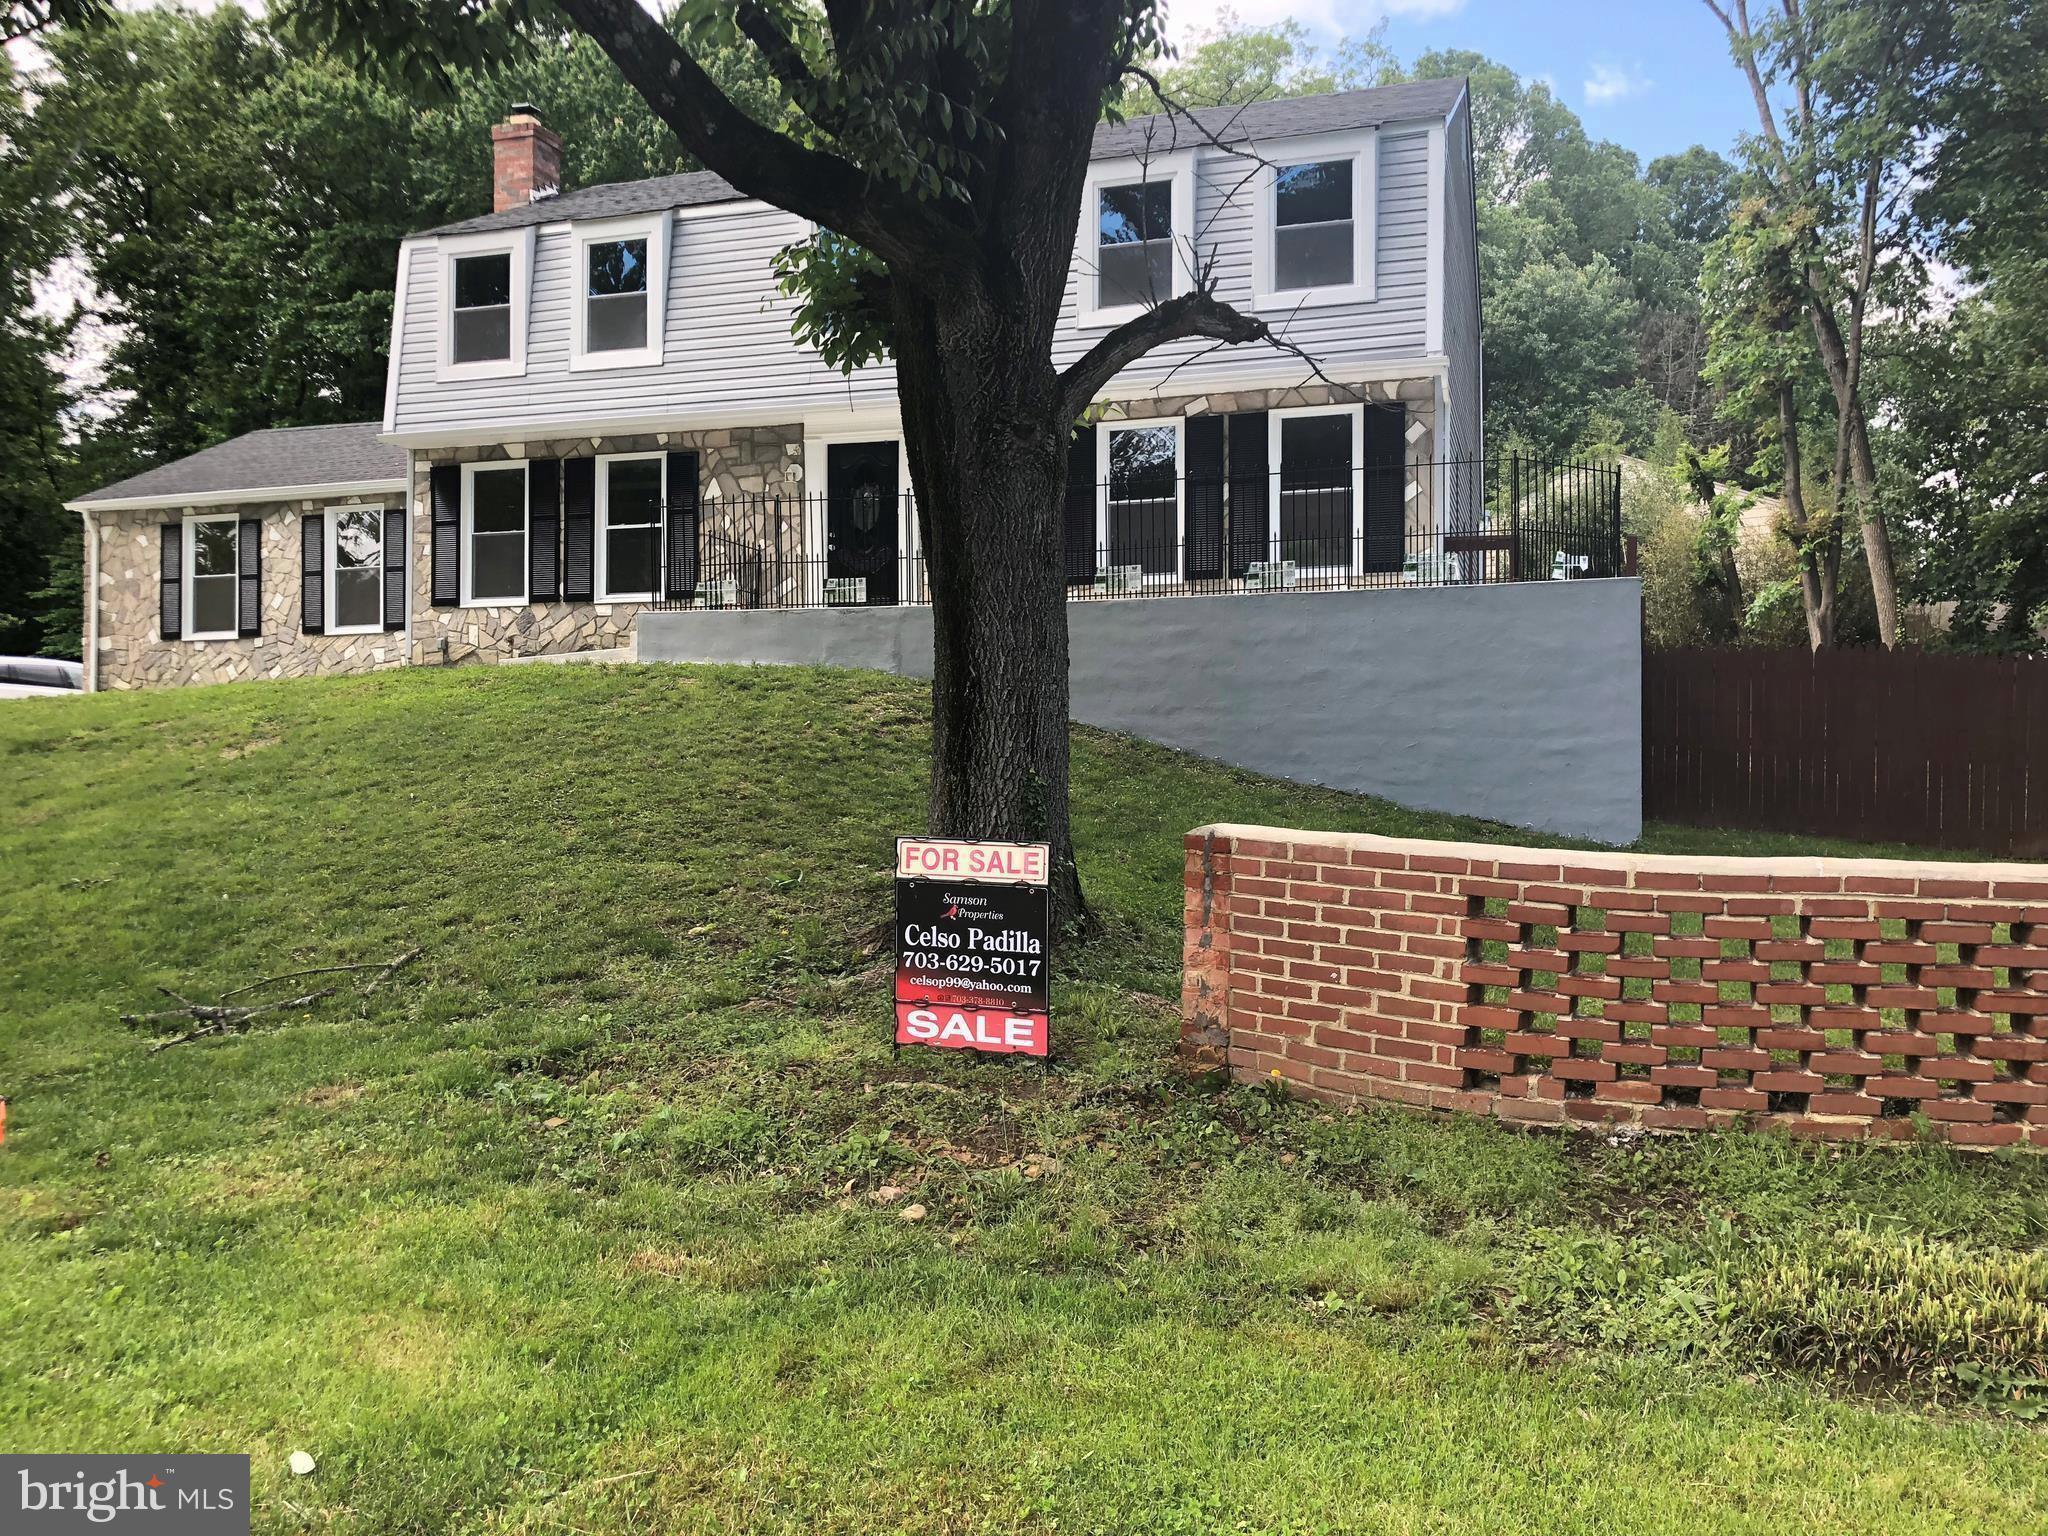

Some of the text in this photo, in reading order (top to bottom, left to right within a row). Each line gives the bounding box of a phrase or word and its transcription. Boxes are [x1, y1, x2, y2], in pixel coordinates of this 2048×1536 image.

[905, 847, 1040, 875] FOR SALE
[943, 893, 987, 906] Samson
[957, 907, 1004, 921] Properties
[904, 924, 1041, 954] Celso Padilla
[902, 951, 1041, 977] 703-629-5017
[910, 975, 1032, 994] celsop99@yahoo.com
[906, 1009, 1035, 1047] SALE
